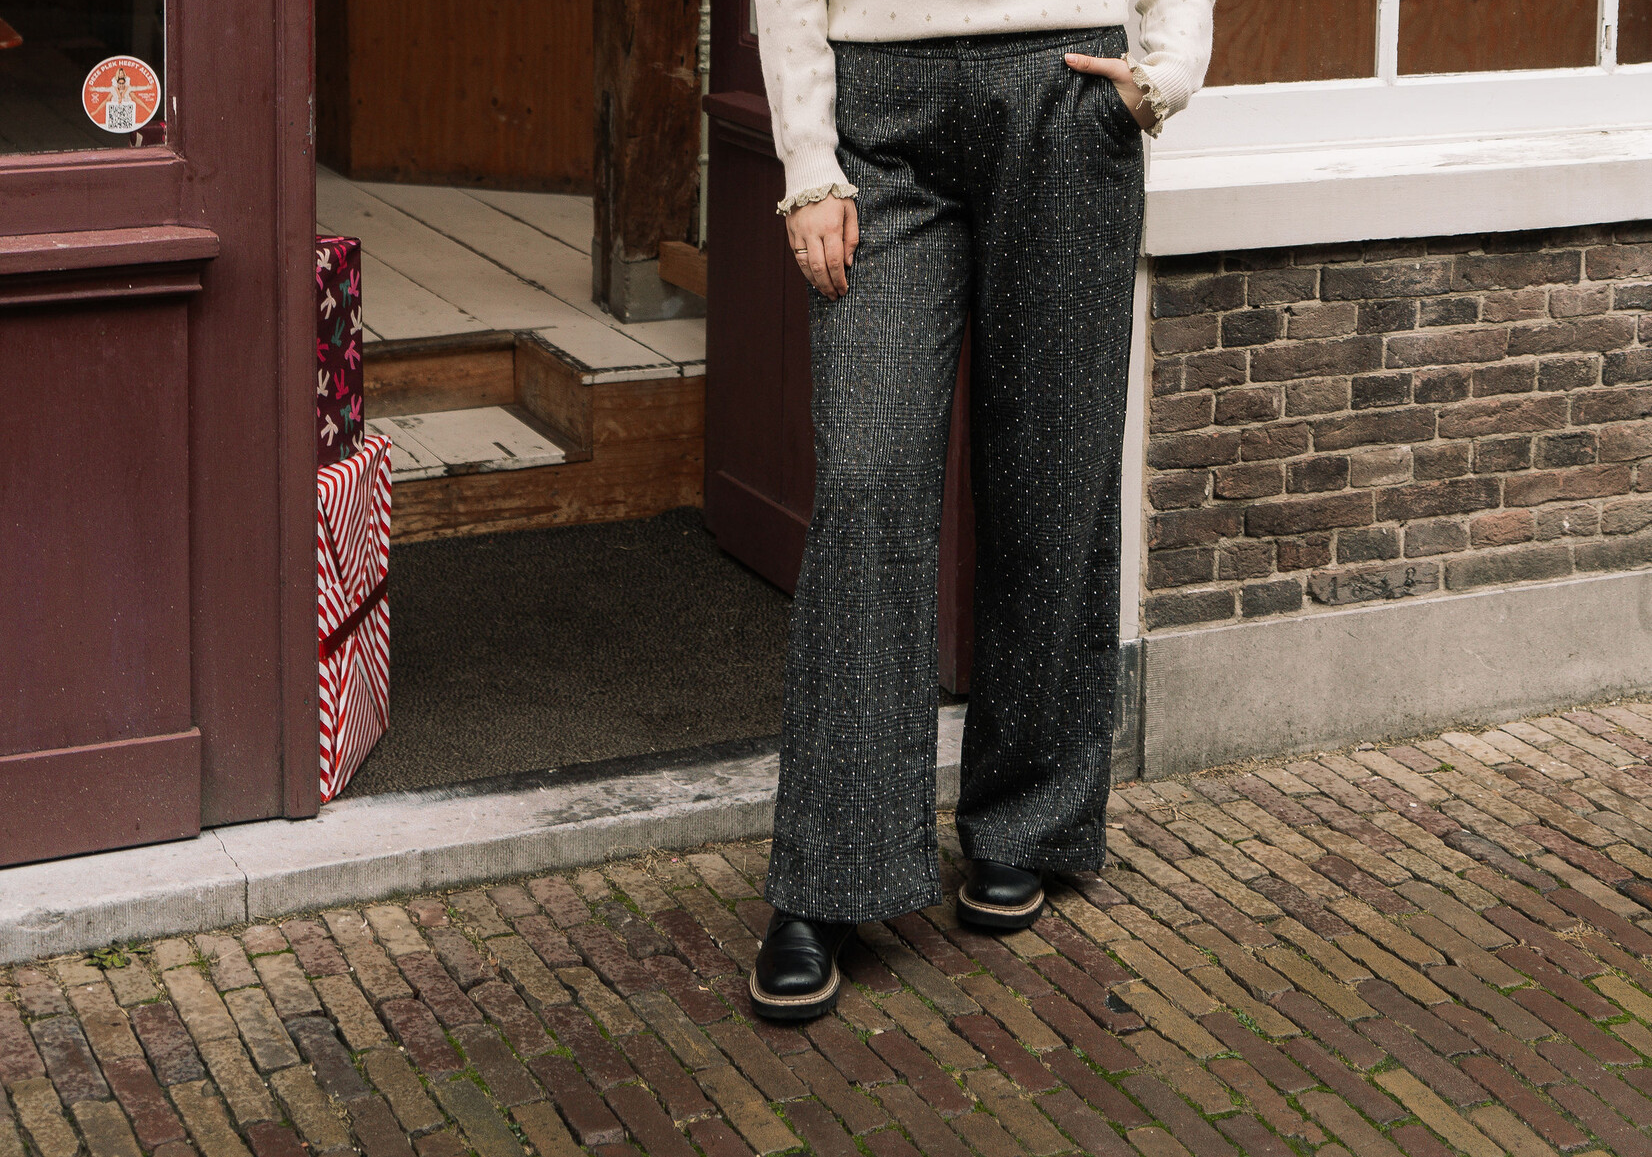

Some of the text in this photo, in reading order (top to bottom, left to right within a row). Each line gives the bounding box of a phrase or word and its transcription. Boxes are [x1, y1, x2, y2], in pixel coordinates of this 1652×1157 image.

[89, 60, 154, 85] DEZE PLEK HEEFT ALLES
